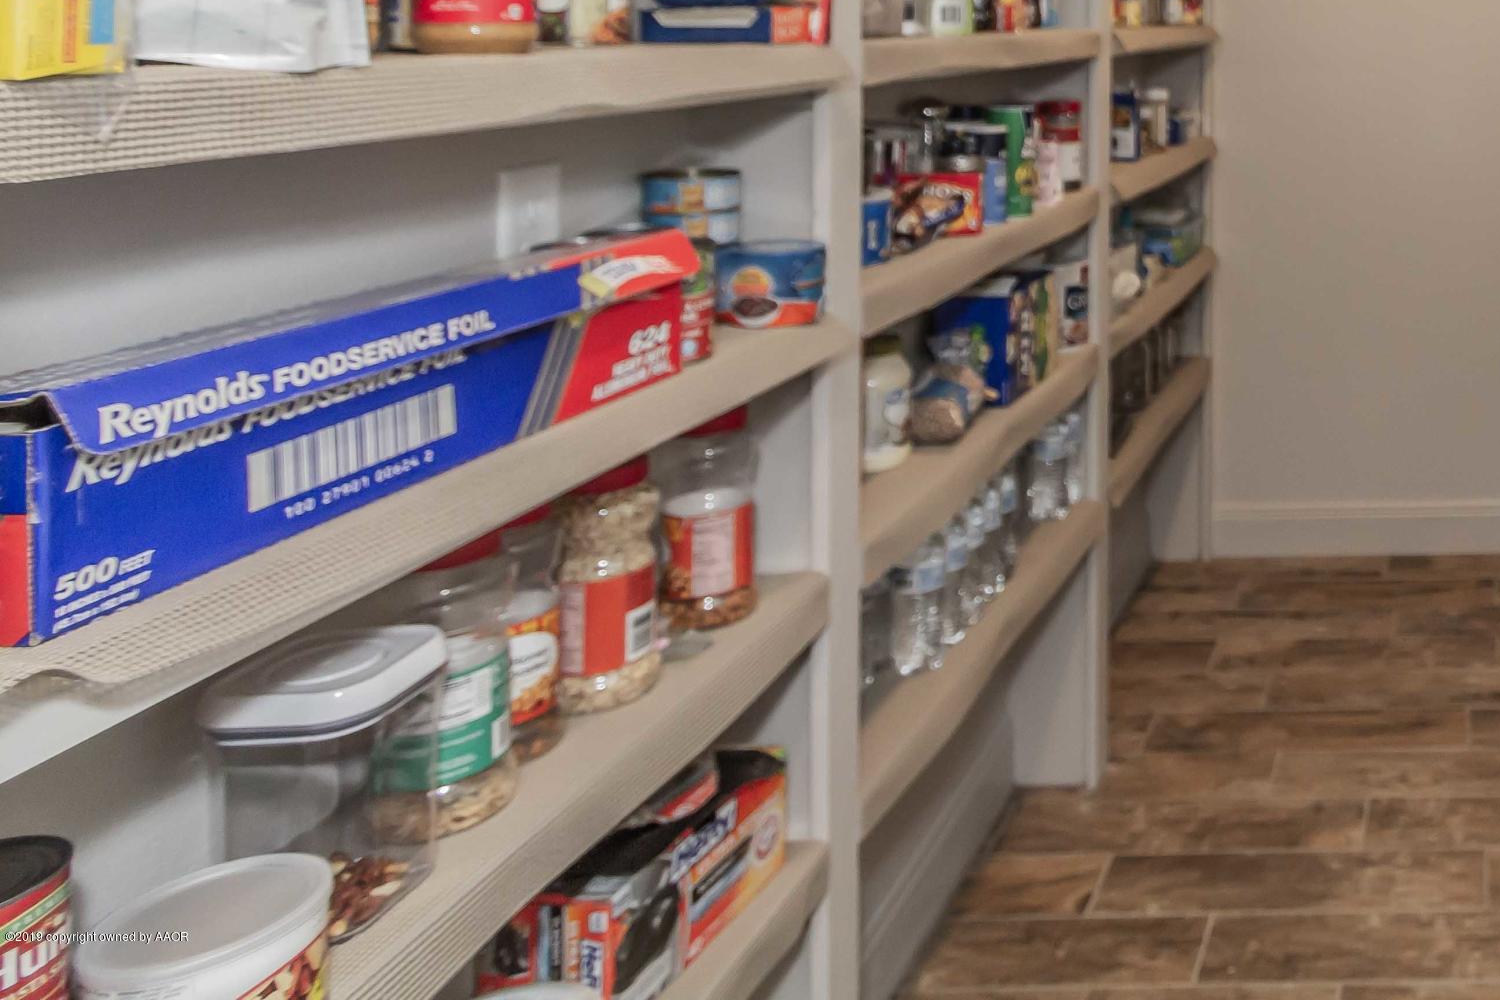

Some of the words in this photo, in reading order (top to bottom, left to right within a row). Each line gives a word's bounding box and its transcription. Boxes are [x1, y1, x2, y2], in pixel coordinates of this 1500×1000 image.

[628, 320, 673, 355] 624
[97, 370, 271, 444] Reynolds
[273, 322, 446, 393] FOODSERVICE
[447, 310, 497, 341] FOIL
[53, 556, 120, 601] 500
